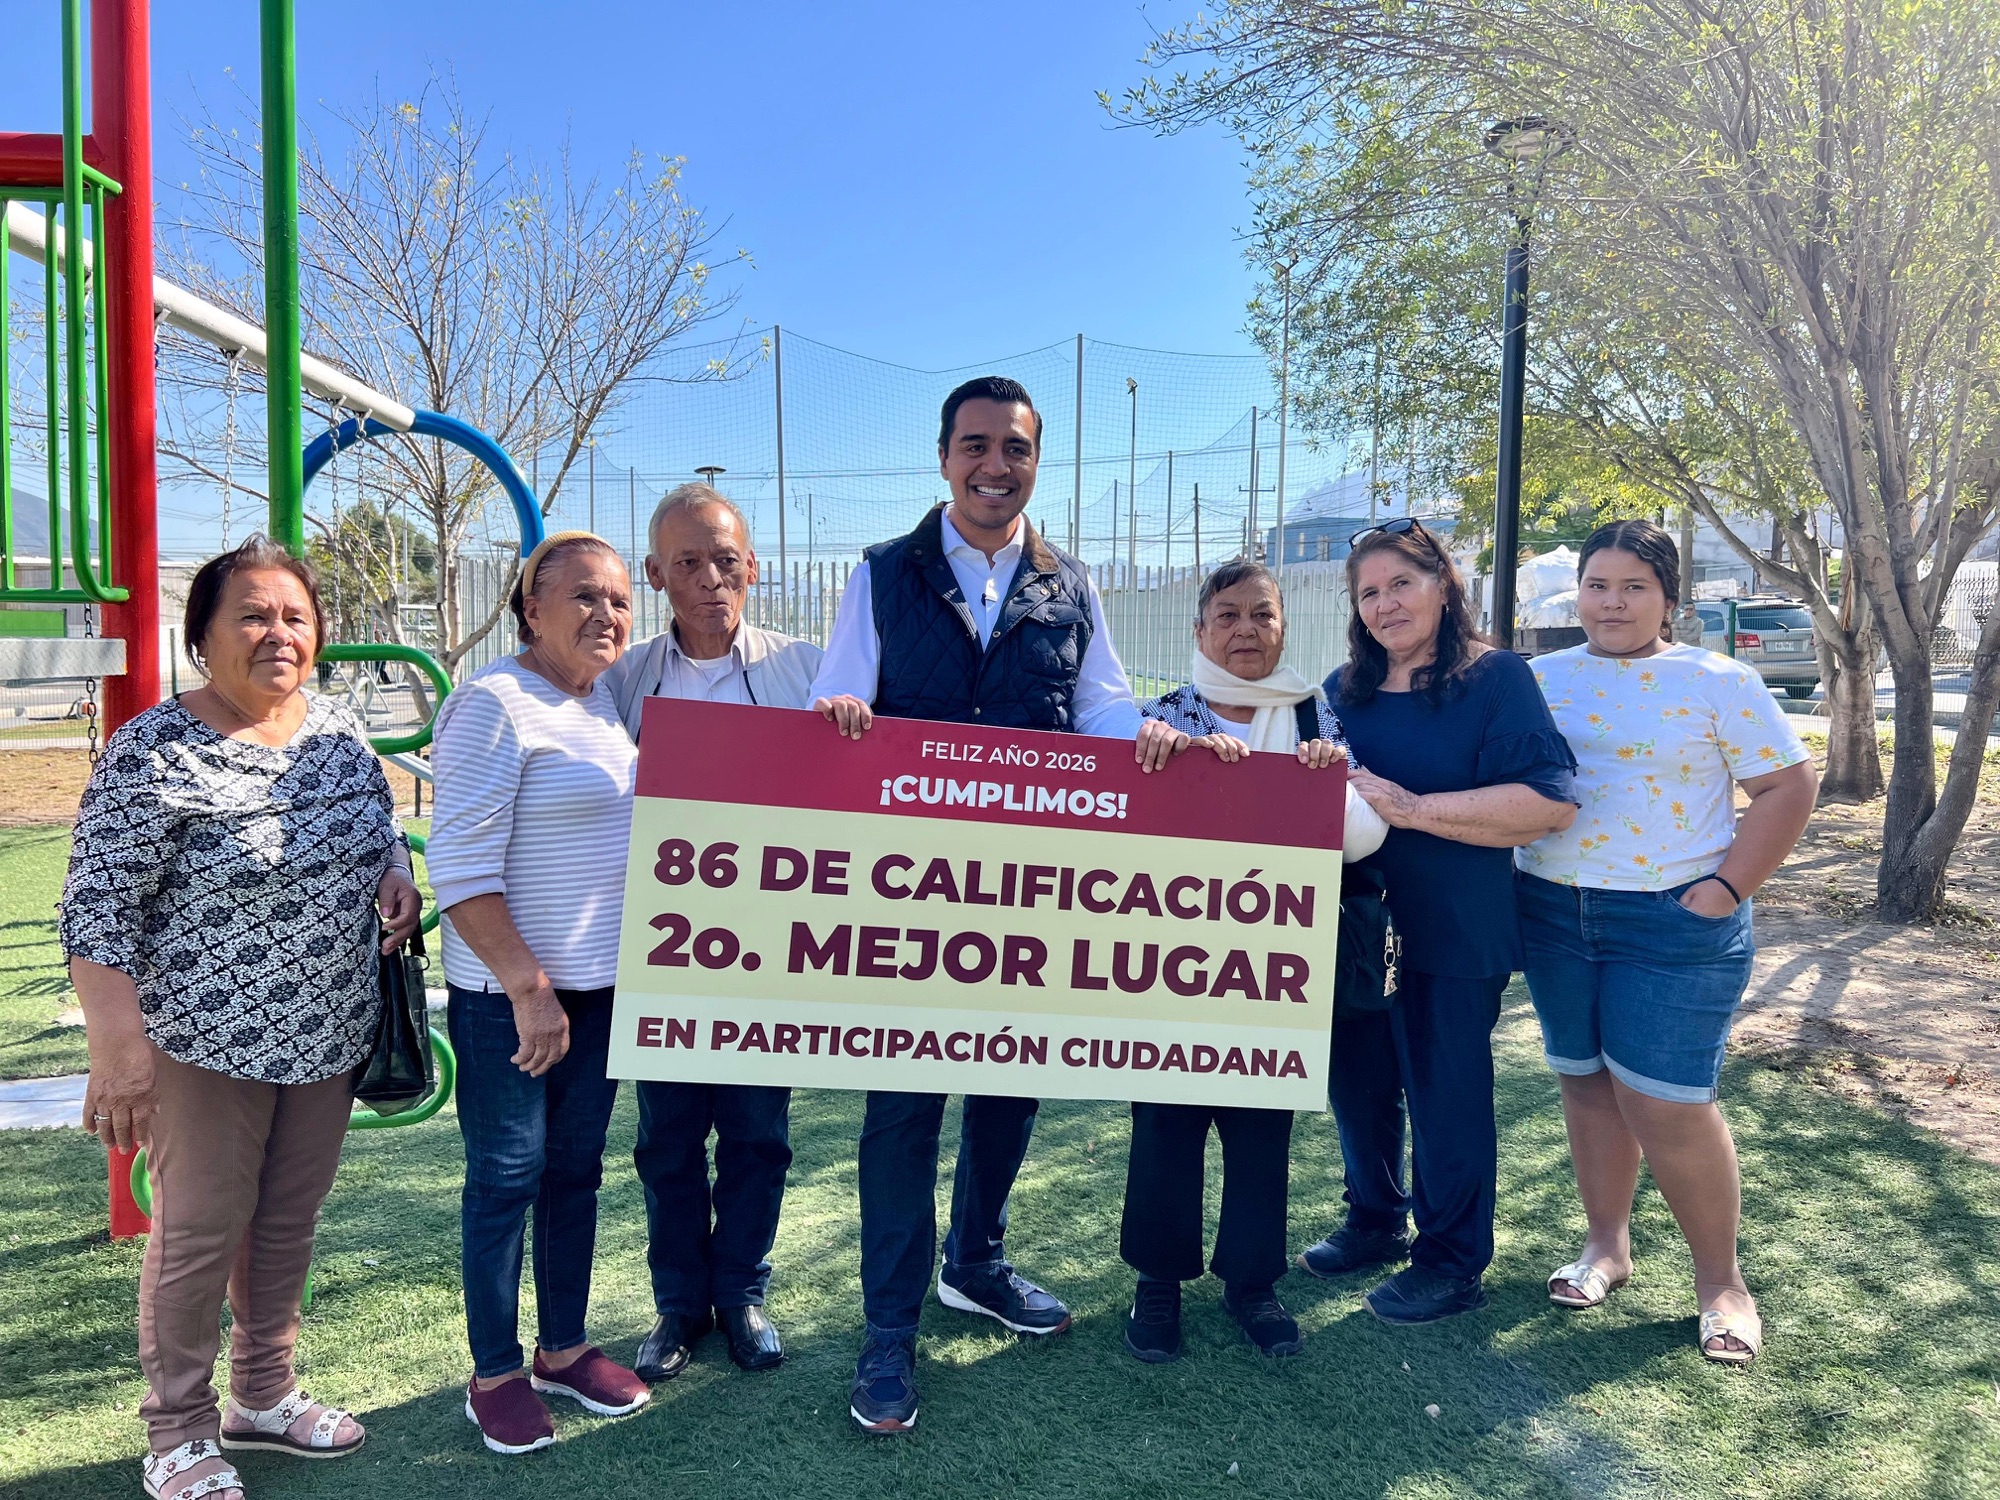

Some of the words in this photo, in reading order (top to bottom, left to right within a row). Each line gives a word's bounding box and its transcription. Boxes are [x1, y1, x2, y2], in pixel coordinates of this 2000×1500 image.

[921, 740, 984, 763] FELIZ
[987, 744, 1040, 768] AÑO
[1044, 751, 1097, 773] 2026
[879, 774, 1128, 821] ¡CUMPLIMOS!
[653, 838, 740, 889] 86
[759, 845, 851, 896] DE
[870, 854, 1316, 928] CALIFICACIÓN
[646, 912, 762, 972] 2o.
[787, 921, 1048, 988] MEJOR
[1070, 938, 1310, 1004] LUGAR
[636, 1016, 697, 1050] EN
[710, 1020, 1049, 1065] PARTICIPACIÓN
[1060, 1037, 1308, 1079] CIUDADANA
